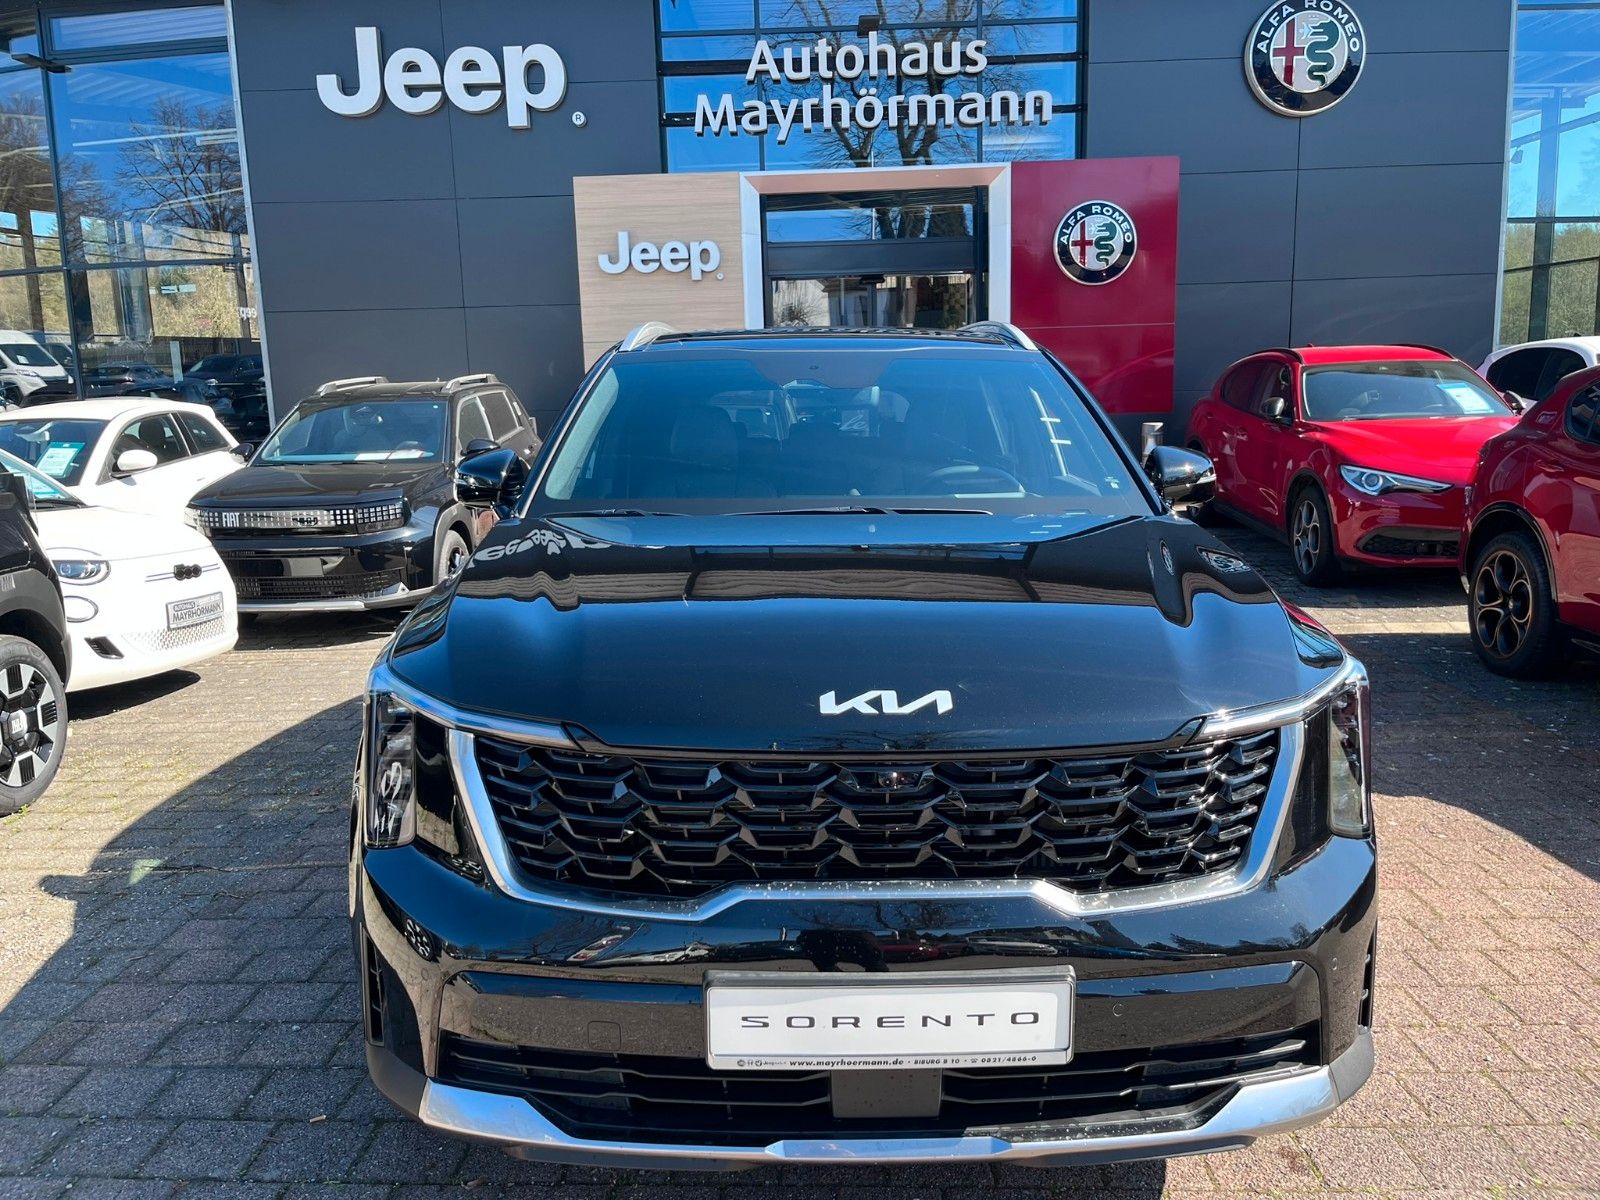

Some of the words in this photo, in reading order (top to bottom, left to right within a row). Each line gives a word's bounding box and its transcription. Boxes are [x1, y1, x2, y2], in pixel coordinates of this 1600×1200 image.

[1257, 4, 1296, 54] ALFA
[1304, 0, 1361, 52] ROMEO
[316, 26, 567, 130] Jeep
[745, 31, 988, 84] Autohaus
[694, 84, 1053, 145] Mayrhörmann
[1060, 210, 1086, 245] ALFA
[1091, 205, 1133, 243] ROMEO
[597, 230, 720, 281] Jeep
[222, 512, 240, 527] FIAT
[819, 690, 953, 715] KIA
[741, 1011, 1040, 1029] SORENTO
[789, 1057, 904, 1068] www.mayrhoermann.de
[914, 1057, 941, 1065] BIBURG
